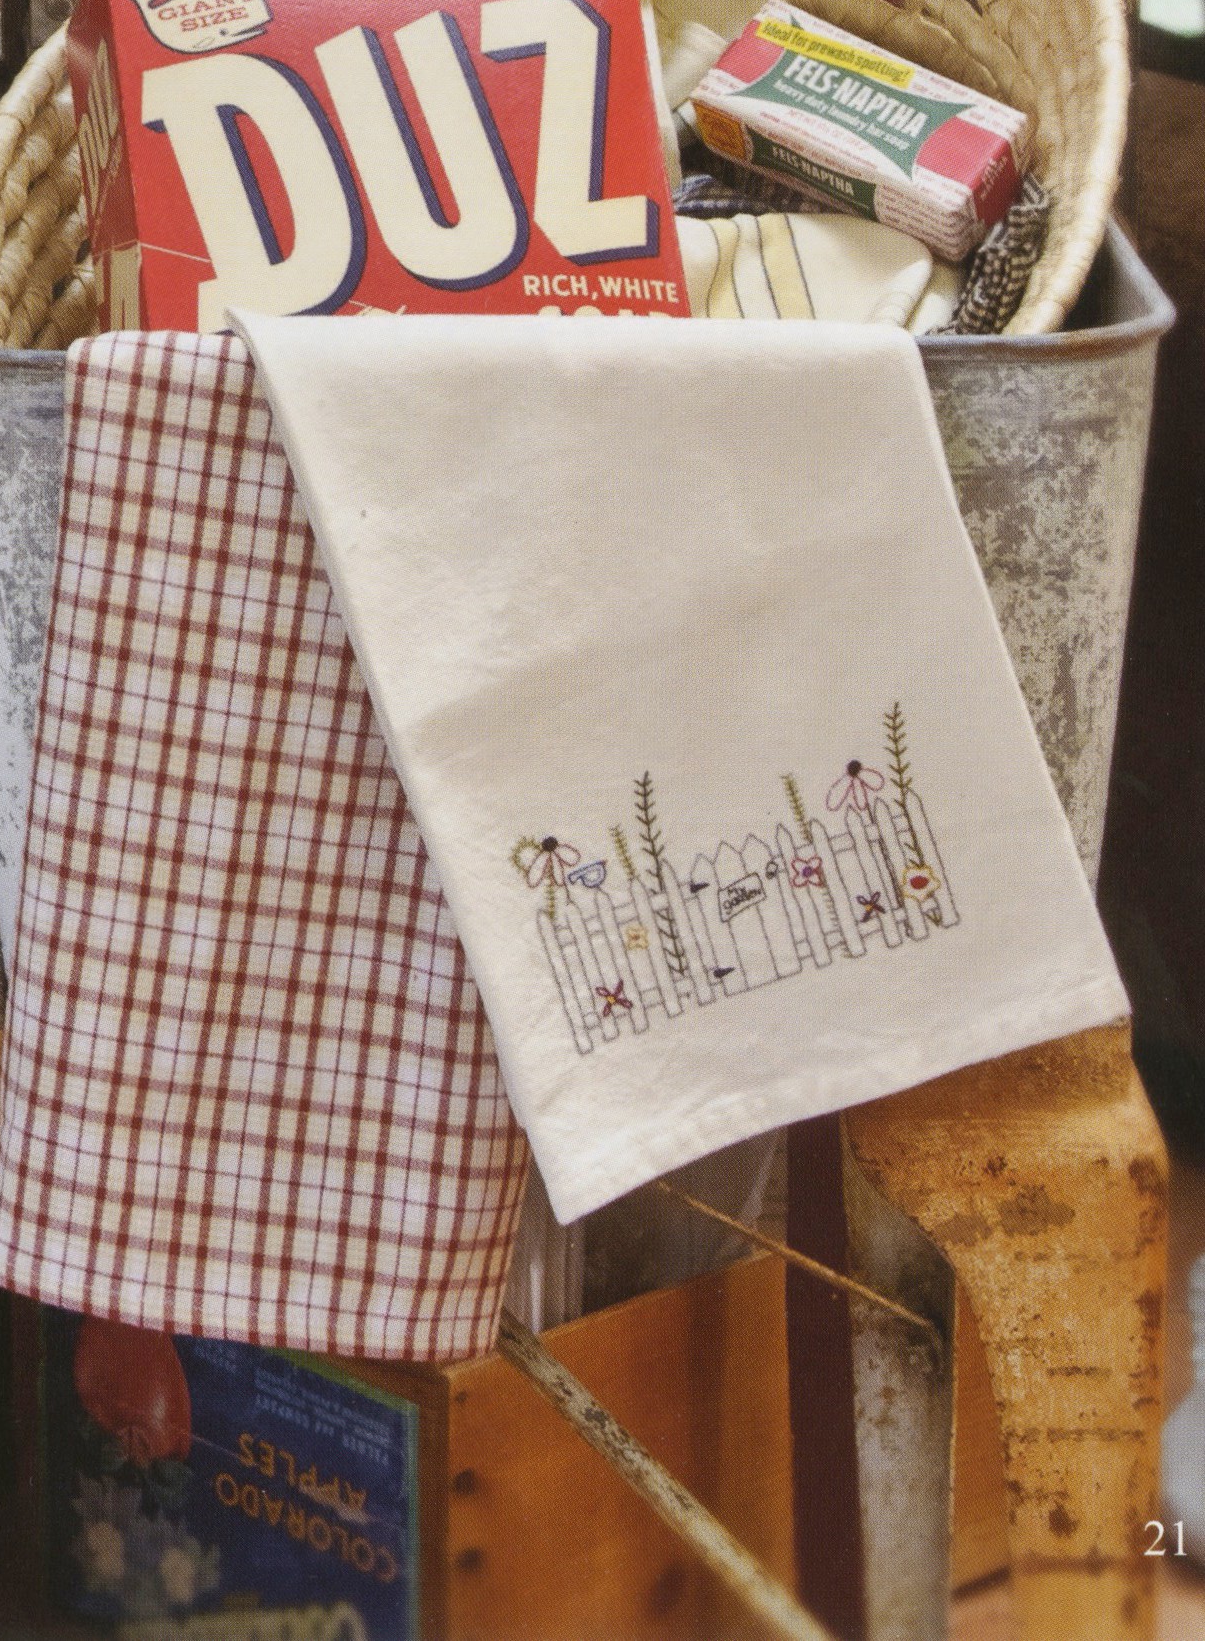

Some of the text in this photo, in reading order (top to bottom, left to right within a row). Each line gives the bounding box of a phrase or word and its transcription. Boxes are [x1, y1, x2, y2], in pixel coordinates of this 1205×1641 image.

[179, 6, 250, 33] SIZE
[789, 31, 808, 49] for
[806, 38, 856, 62] prewash
[773, 78, 806, 103] heavy
[803, 90, 830, 114] duty
[827, 103, 869, 132] laundry
[866, 121, 886, 139] bar
[883, 133, 911, 152] soap
[598, 274, 680, 304] WHITE
[237, 1431, 367, 1520] APPLES
[214, 1471, 398, 1584] COLORADO
